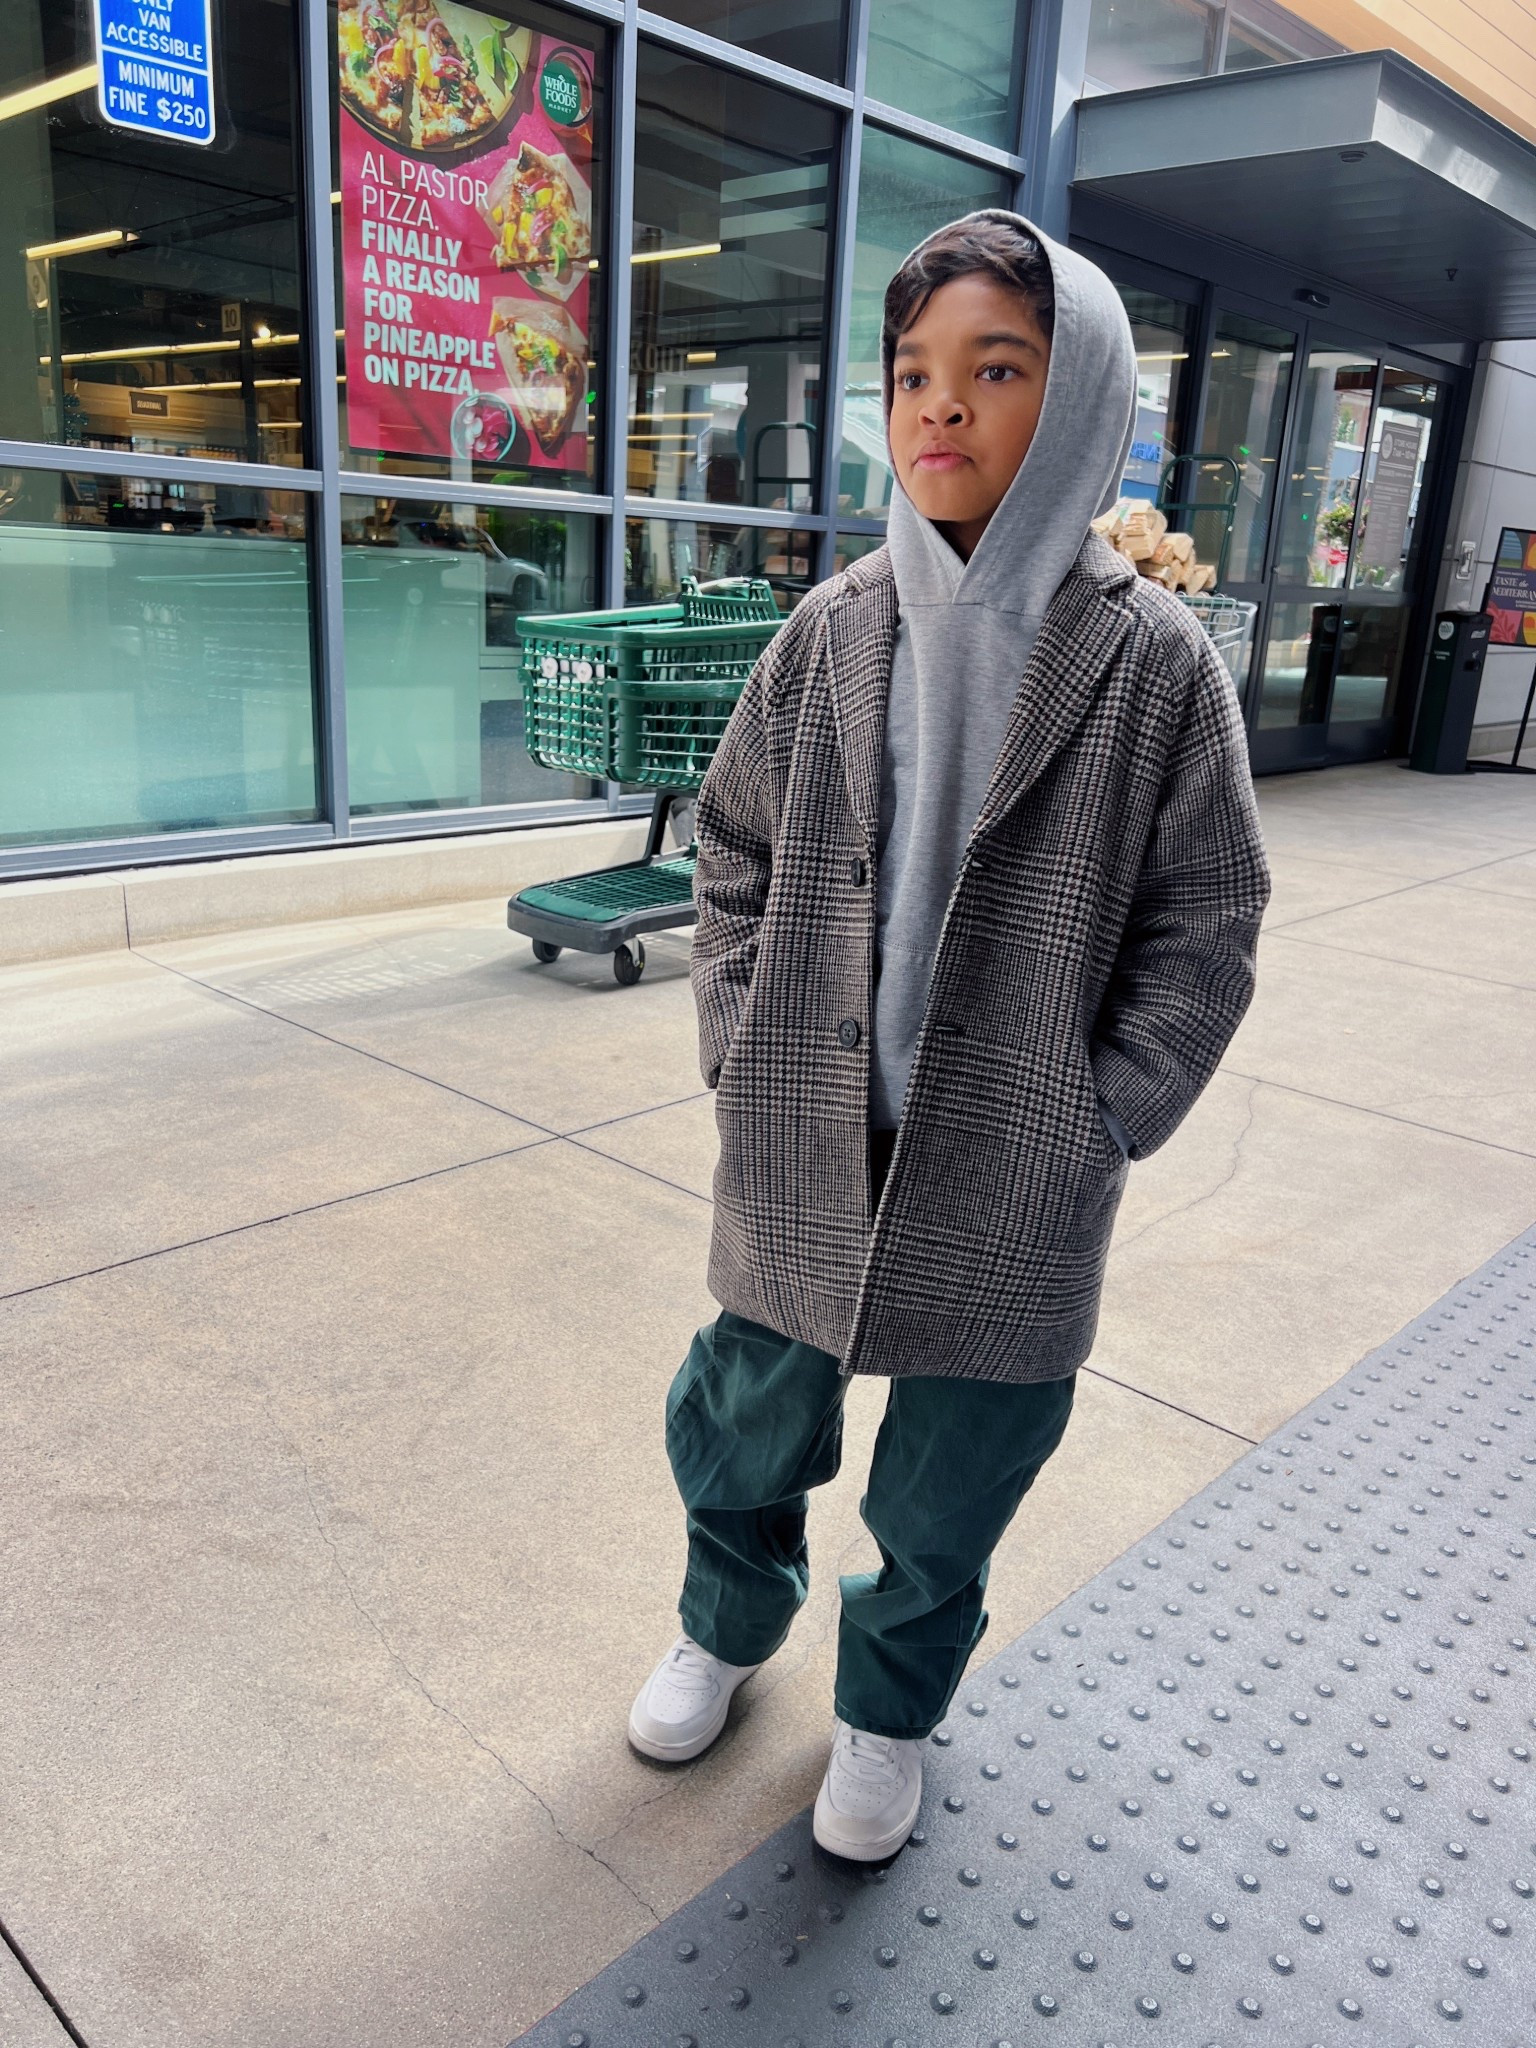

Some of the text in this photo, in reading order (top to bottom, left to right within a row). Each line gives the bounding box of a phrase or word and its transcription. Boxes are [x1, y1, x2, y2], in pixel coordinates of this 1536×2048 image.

[138, 8, 171, 33] VAN
[106, 21, 204, 63] ACCESSIBLE
[118, 59, 195, 98] MINIMUM
[543, 75, 578, 97] WHOLE
[109, 86, 206, 129] FINE $250
[545, 88, 577, 109] FOODS
[548, 103, 572, 114] MARKET
[361, 150, 489, 210] AL PASTOR
[362, 184, 440, 231] PIZZA.
[361, 219, 463, 268] FINALLY
[362, 254, 480, 305] A REASON
[223, 308, 238, 328] 10
[364, 287, 413, 324] FOR
[364, 320, 496, 370] PINEAPPLE
[364, 354, 400, 387] ON
[1494, 576, 1519, 587] TASTE
